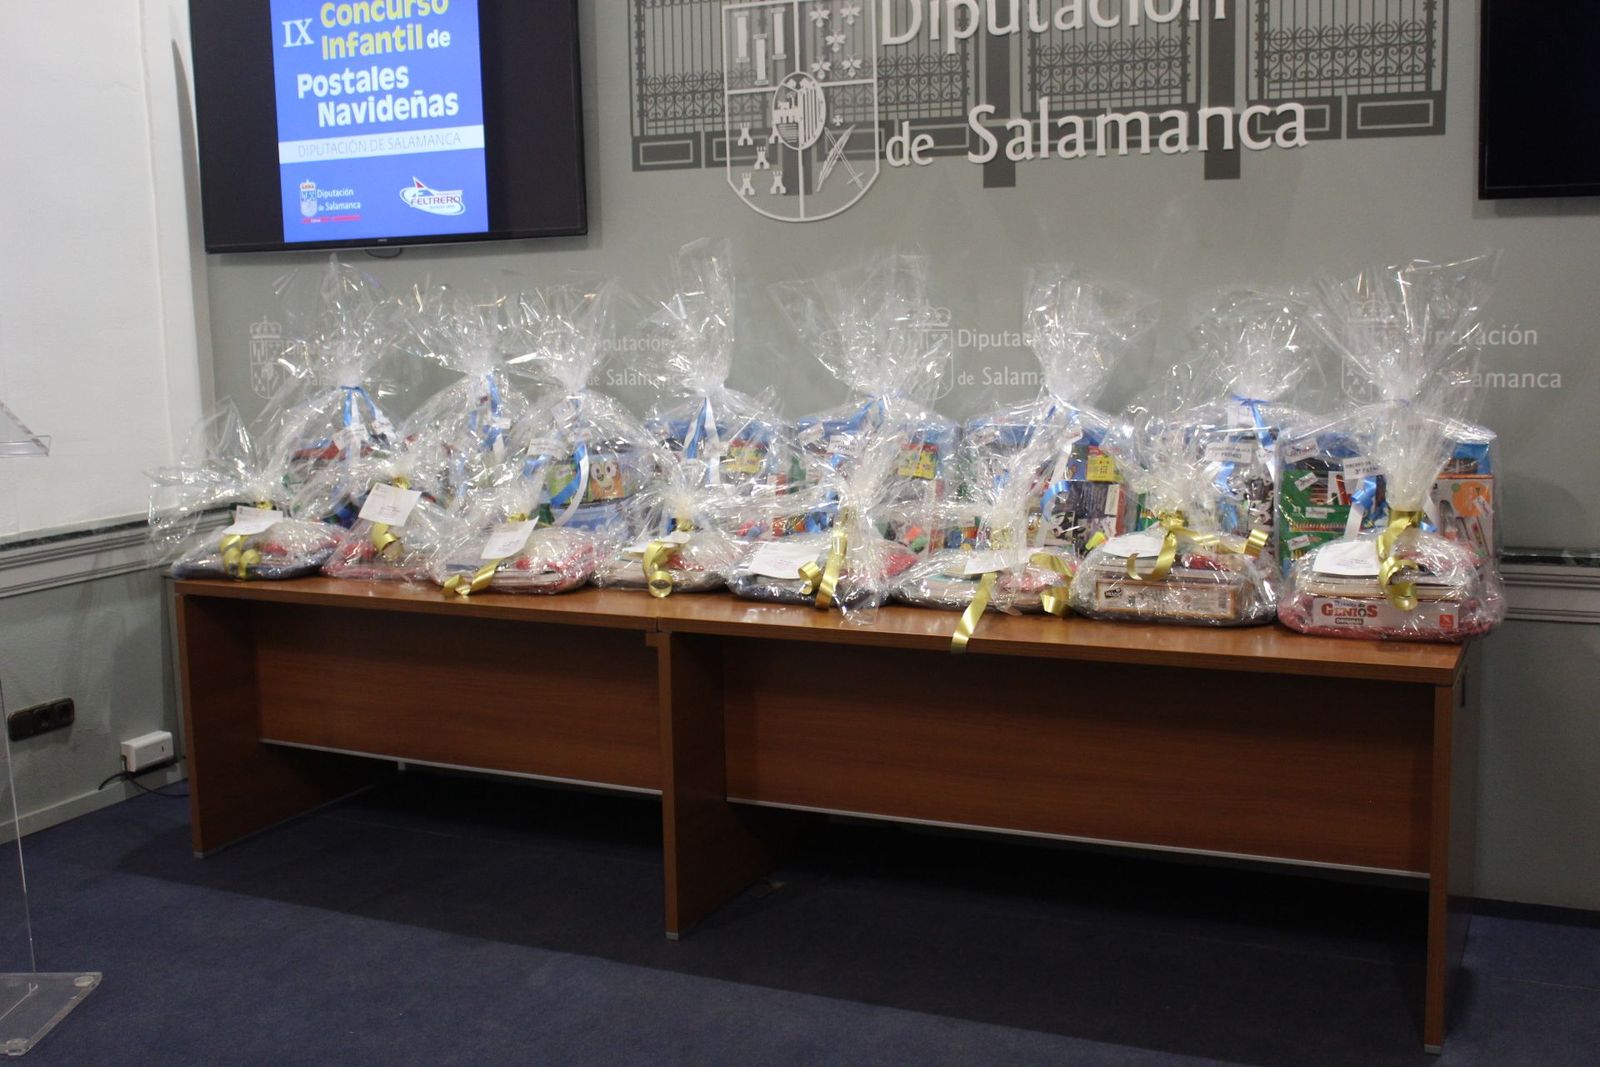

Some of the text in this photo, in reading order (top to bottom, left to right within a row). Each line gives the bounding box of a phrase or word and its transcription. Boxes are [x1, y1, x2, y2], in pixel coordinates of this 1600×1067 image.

[320, 0, 449, 28] Concurso
[282, 18, 314, 47] IX
[321, 24, 451, 60] Infantil de
[297, 66, 409, 99] Postales
[317, 90, 459, 127] Navideñas
[298, 132, 462, 158] DIPUTACIÓN DE SALAMANCA
[885, 97, 1310, 167] de Salamanca
[410, 196, 460, 206] FELTRERO
[957, 329, 1032, 351] Diputac
[957, 366, 1048, 386] de Salama
[1321, 603, 1378, 618] GENIOS
